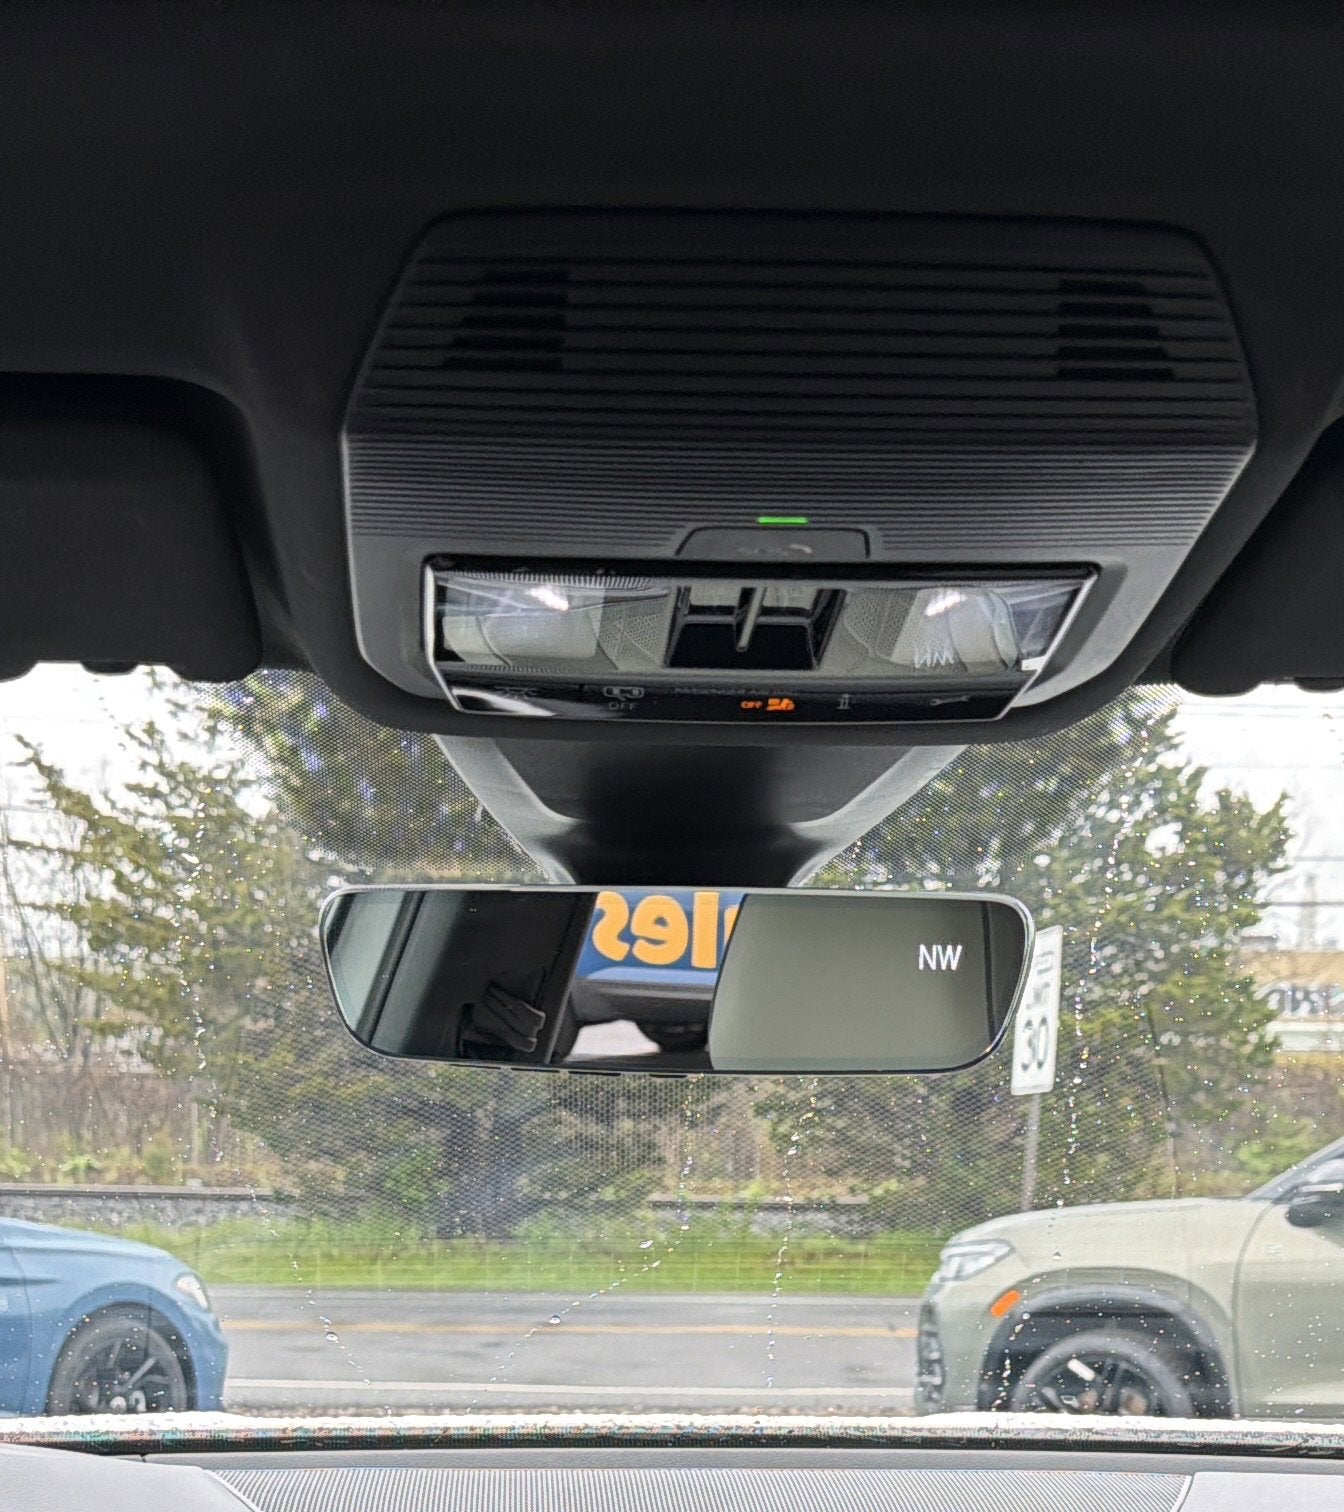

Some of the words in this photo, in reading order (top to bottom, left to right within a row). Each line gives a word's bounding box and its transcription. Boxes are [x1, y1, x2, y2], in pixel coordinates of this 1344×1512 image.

[608, 703, 637, 711] OFF
[919, 944, 963, 970] NW
[1021, 1016, 1050, 1072] 30
